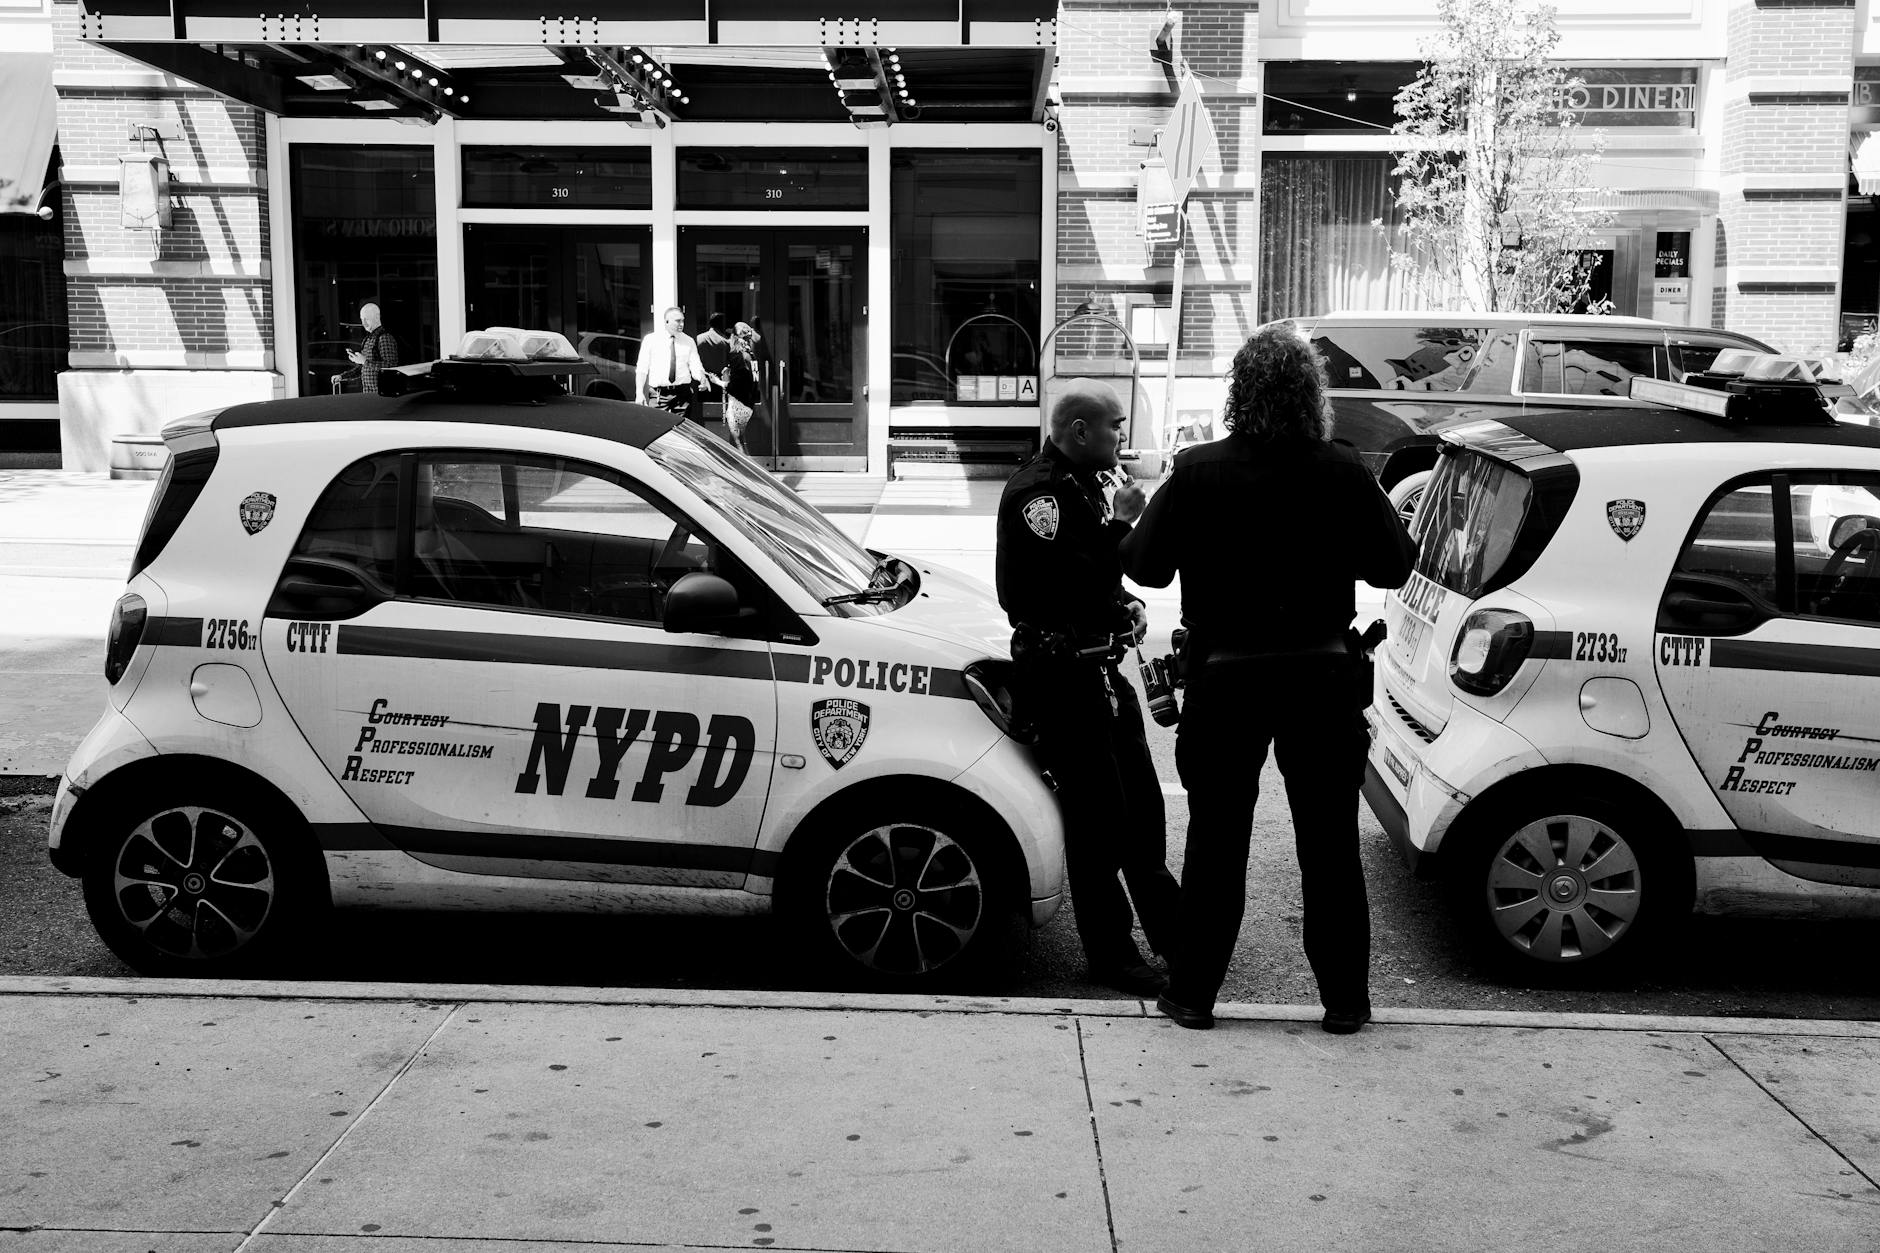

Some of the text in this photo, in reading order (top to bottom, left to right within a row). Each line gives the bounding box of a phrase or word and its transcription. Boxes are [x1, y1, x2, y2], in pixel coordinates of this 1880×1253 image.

[1602, 86, 1686, 109] DINER
[552, 188, 569, 198] 310
[765, 189, 782, 199] 310
[1656, 258, 1684, 266] PECIALS
[1658, 250, 1679, 258] DAILY
[1021, 379, 1034, 394] A
[287, 621, 331, 653] CTTF
[1660, 636, 1705, 667] CTTF
[813, 655, 928, 695] POLICE
[813, 708, 868, 723] DEPARTMENT
[826, 700, 859, 711] POLICE
[354, 726, 494, 758] PROFESSIONALISM
[514, 702, 756, 807] NYPD
[813, 727, 832, 759] CITY OF
[841, 727, 867, 763] NEW YORK
[1737, 738, 1880, 771] PROFESSIONALISM
[341, 755, 415, 784] RESPECT
[1719, 765, 1797, 795] RESPECT
